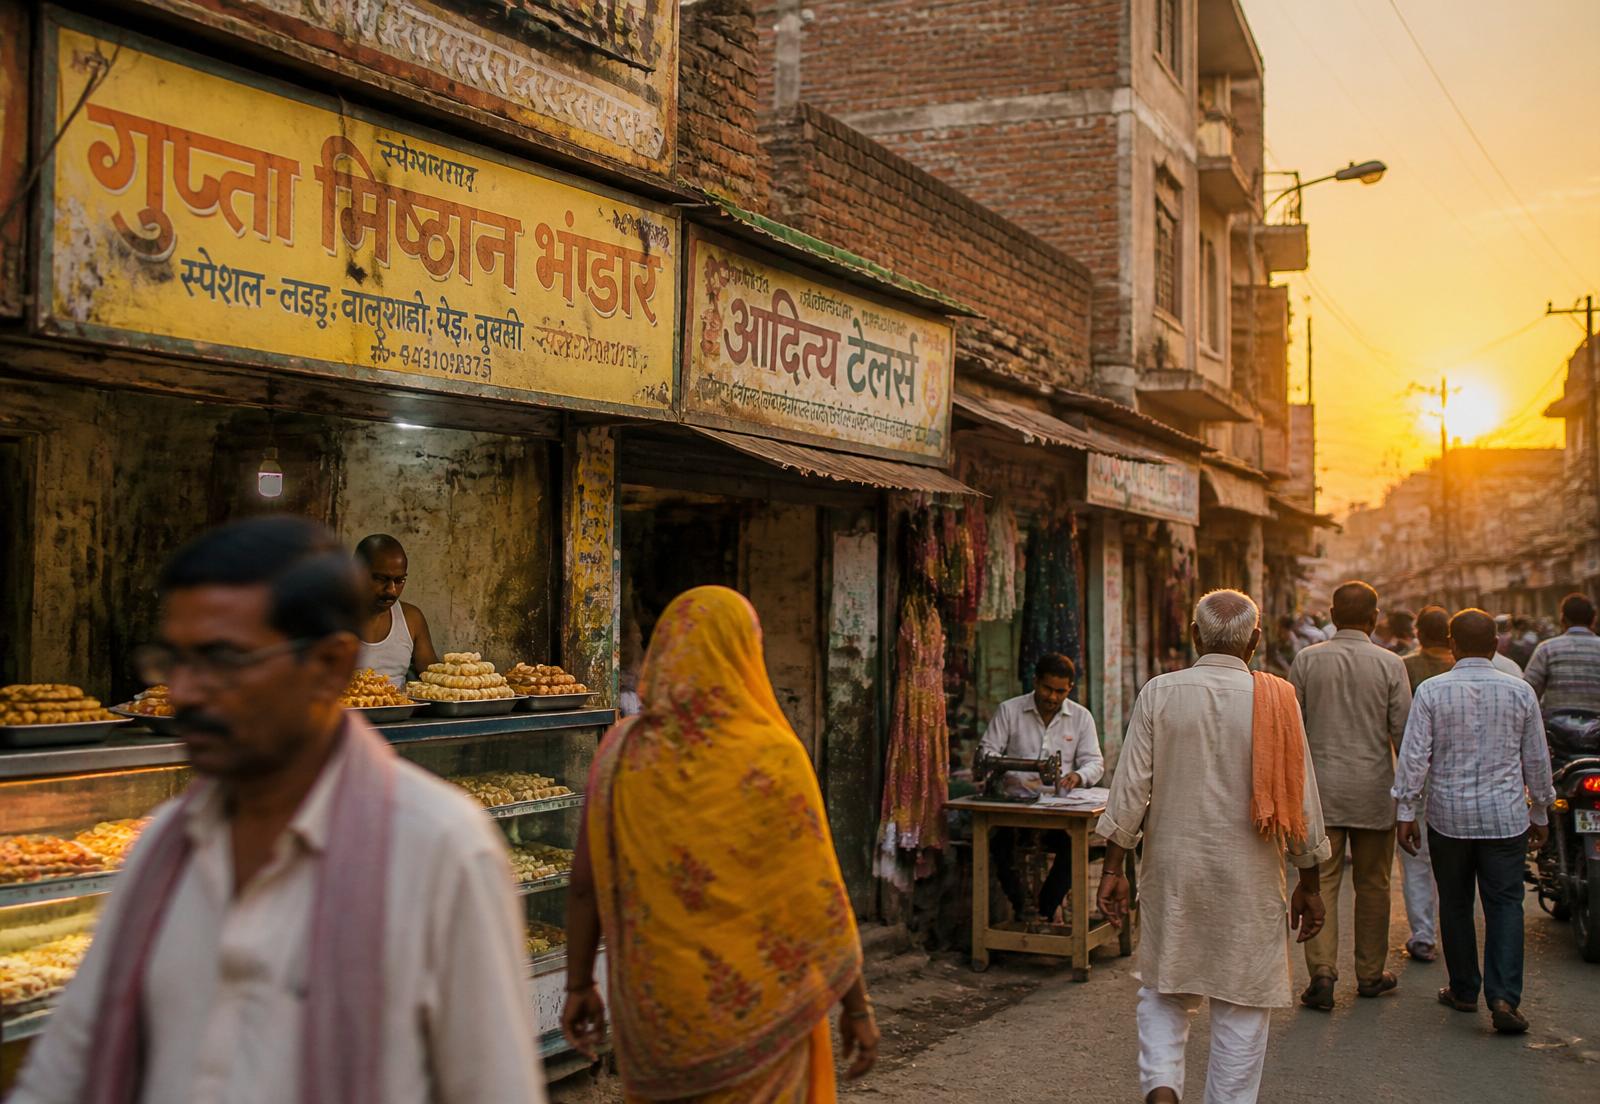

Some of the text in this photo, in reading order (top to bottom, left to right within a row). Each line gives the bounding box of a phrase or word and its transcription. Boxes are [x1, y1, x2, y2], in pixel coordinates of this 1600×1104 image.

[86, 102, 301, 262] गुप्ता
[314, 135, 525, 295] मिष्ठान
[724, 288, 842, 389] आदित्य
[847, 317, 919, 407] टेलर्स
